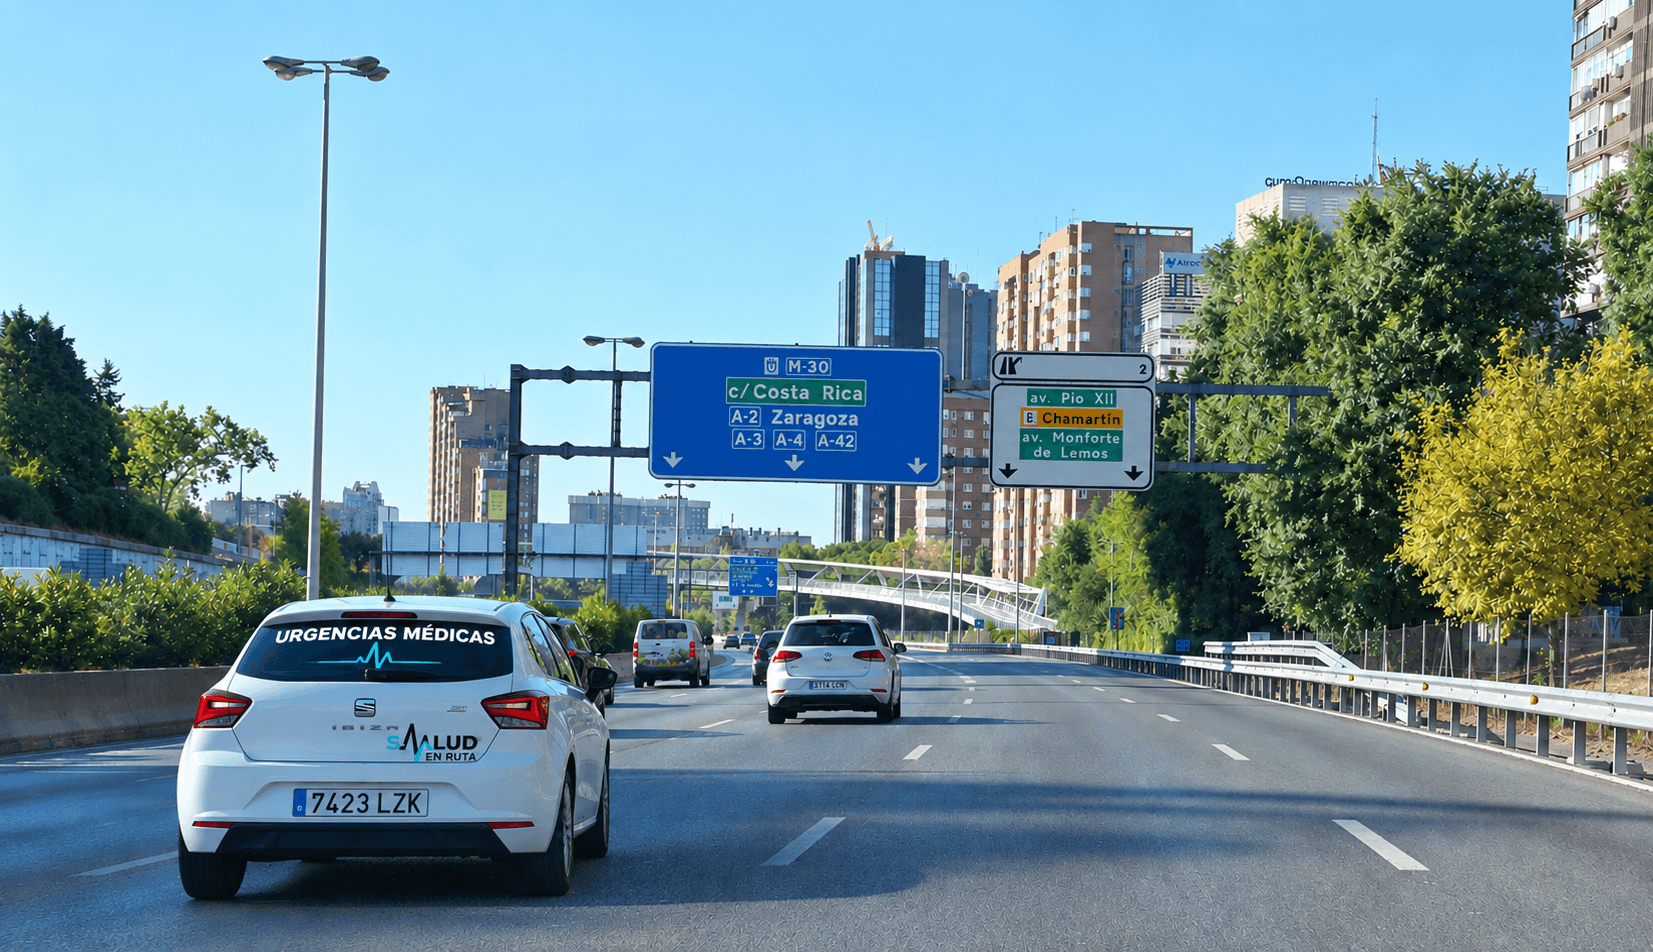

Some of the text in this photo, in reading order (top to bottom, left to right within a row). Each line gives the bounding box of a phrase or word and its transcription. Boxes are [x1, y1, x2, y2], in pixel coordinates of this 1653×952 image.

[789, 360, 829, 374] M-30
[1139, 364, 1147, 375] 2
[822, 385, 863, 401] Rica
[1030, 392, 1114, 405] av. Pio XII
[731, 410, 859, 429] A-2 Zaragoza
[1042, 412, 1120, 425] Chamartín
[735, 433, 854, 448] A-3 A-4 A-42
[1022, 432, 1120, 444] av. Monforte
[1033, 447, 1109, 459] de Lemos
[275, 624, 496, 645] URGENCIAS MÉDICAS
[386, 723, 478, 762] SALUD
[425, 752, 477, 761] EN RUTA
[312, 792, 422, 814] 7423 LZK
